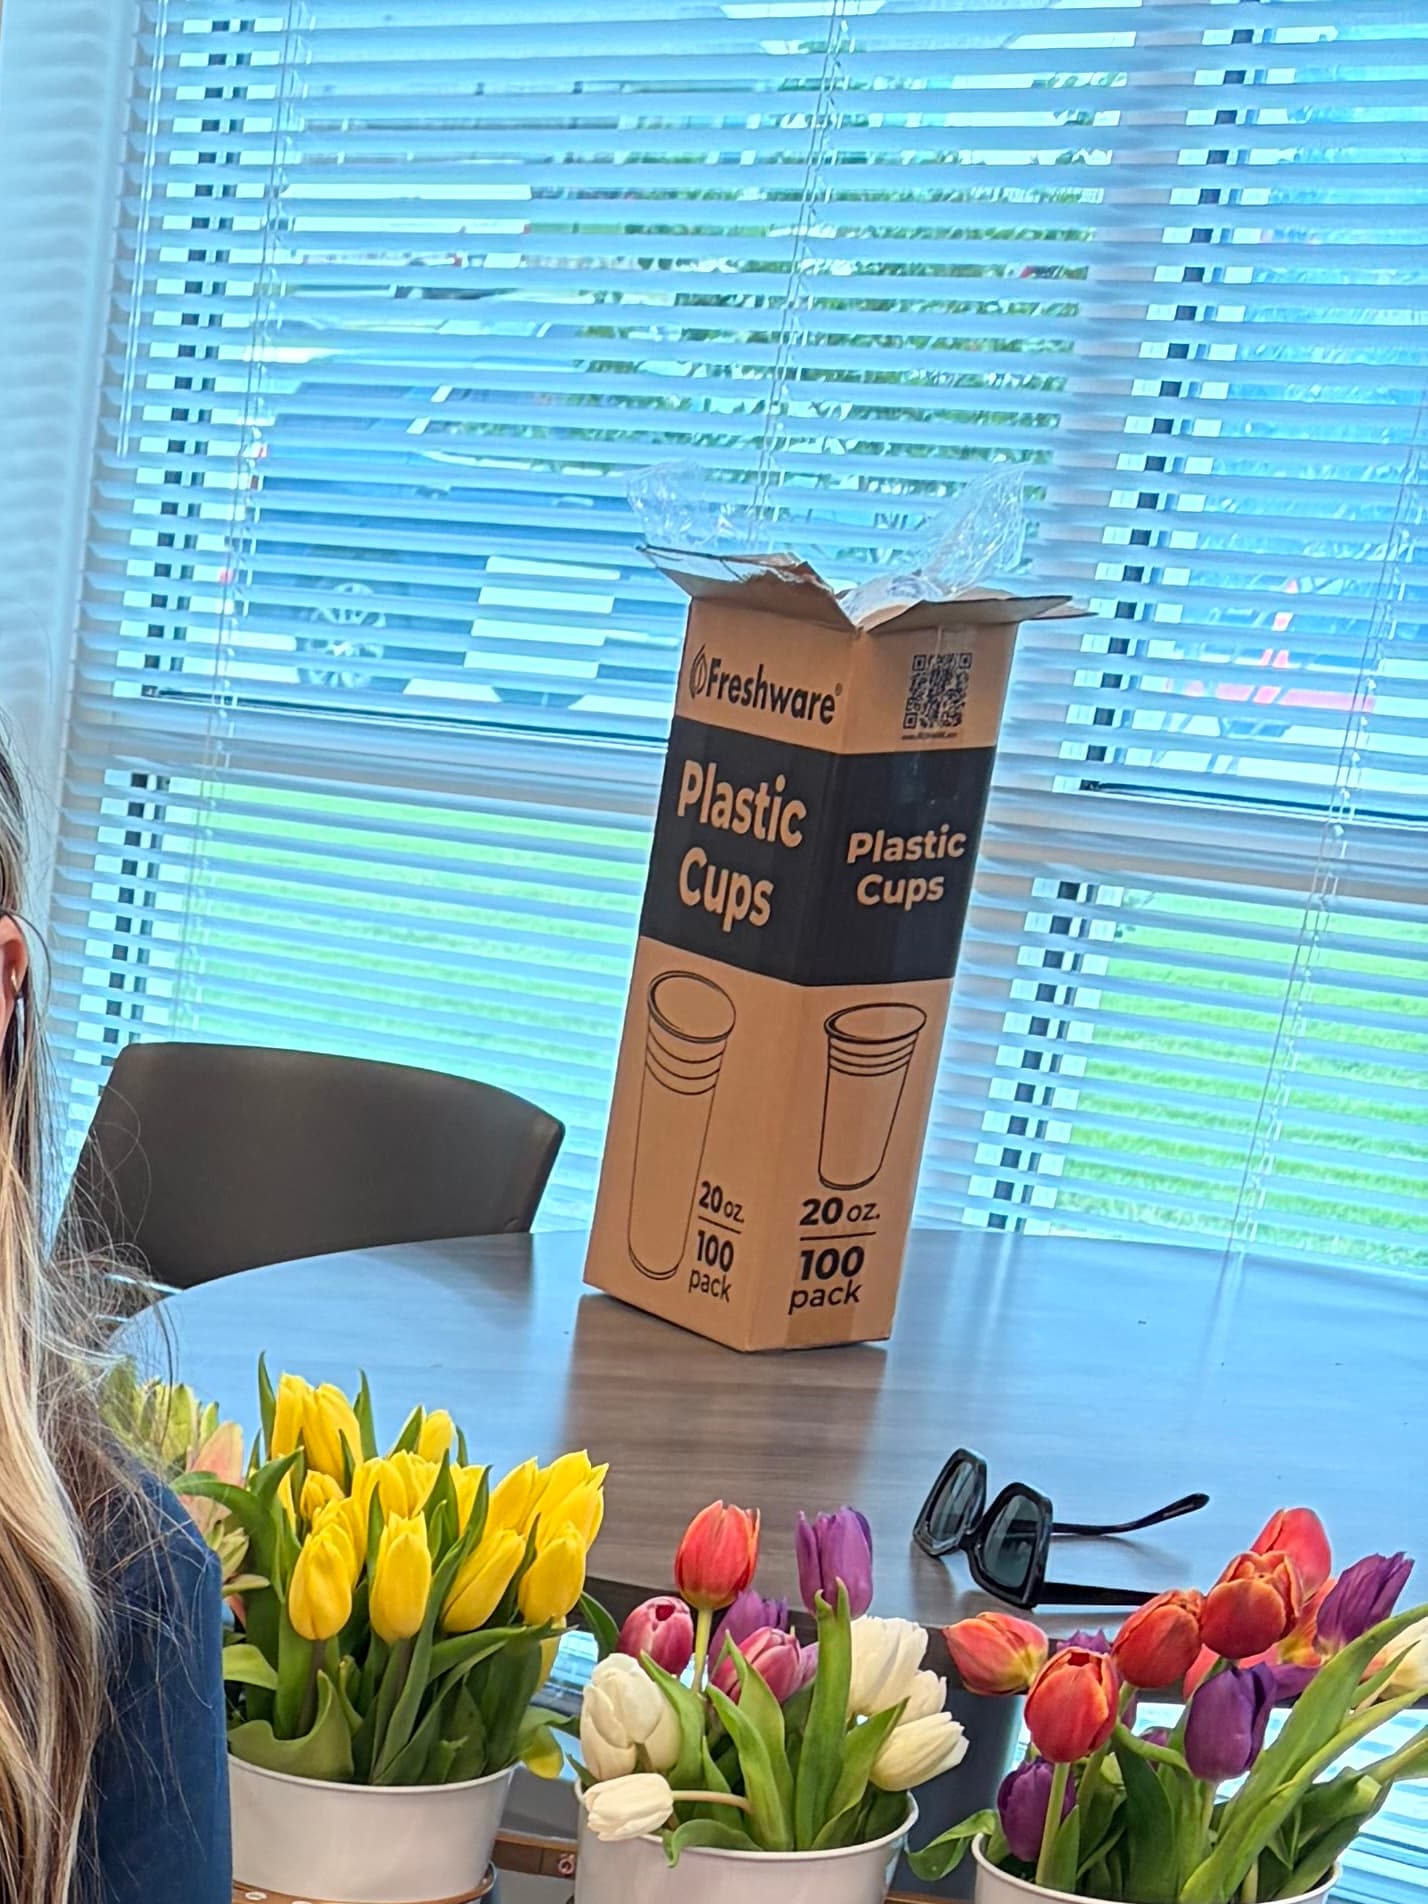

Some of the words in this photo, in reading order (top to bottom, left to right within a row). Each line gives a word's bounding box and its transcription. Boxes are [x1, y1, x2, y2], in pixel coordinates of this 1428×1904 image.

[705, 657, 836, 725] Freshware
[677, 759, 807, 848] Plastic
[847, 823, 967, 864] Plastic
[679, 846, 775, 933] Cups
[856, 873, 945, 911] Cups
[699, 1180, 723, 1213] 20
[799, 1197, 843, 1226] 20
[846, 1202, 881, 1222] oz.
[697, 1229, 734, 1272] 100
[800, 1246, 865, 1281] 100
[688, 1269, 732, 1303] pack
[788, 1279, 863, 1315] pack
